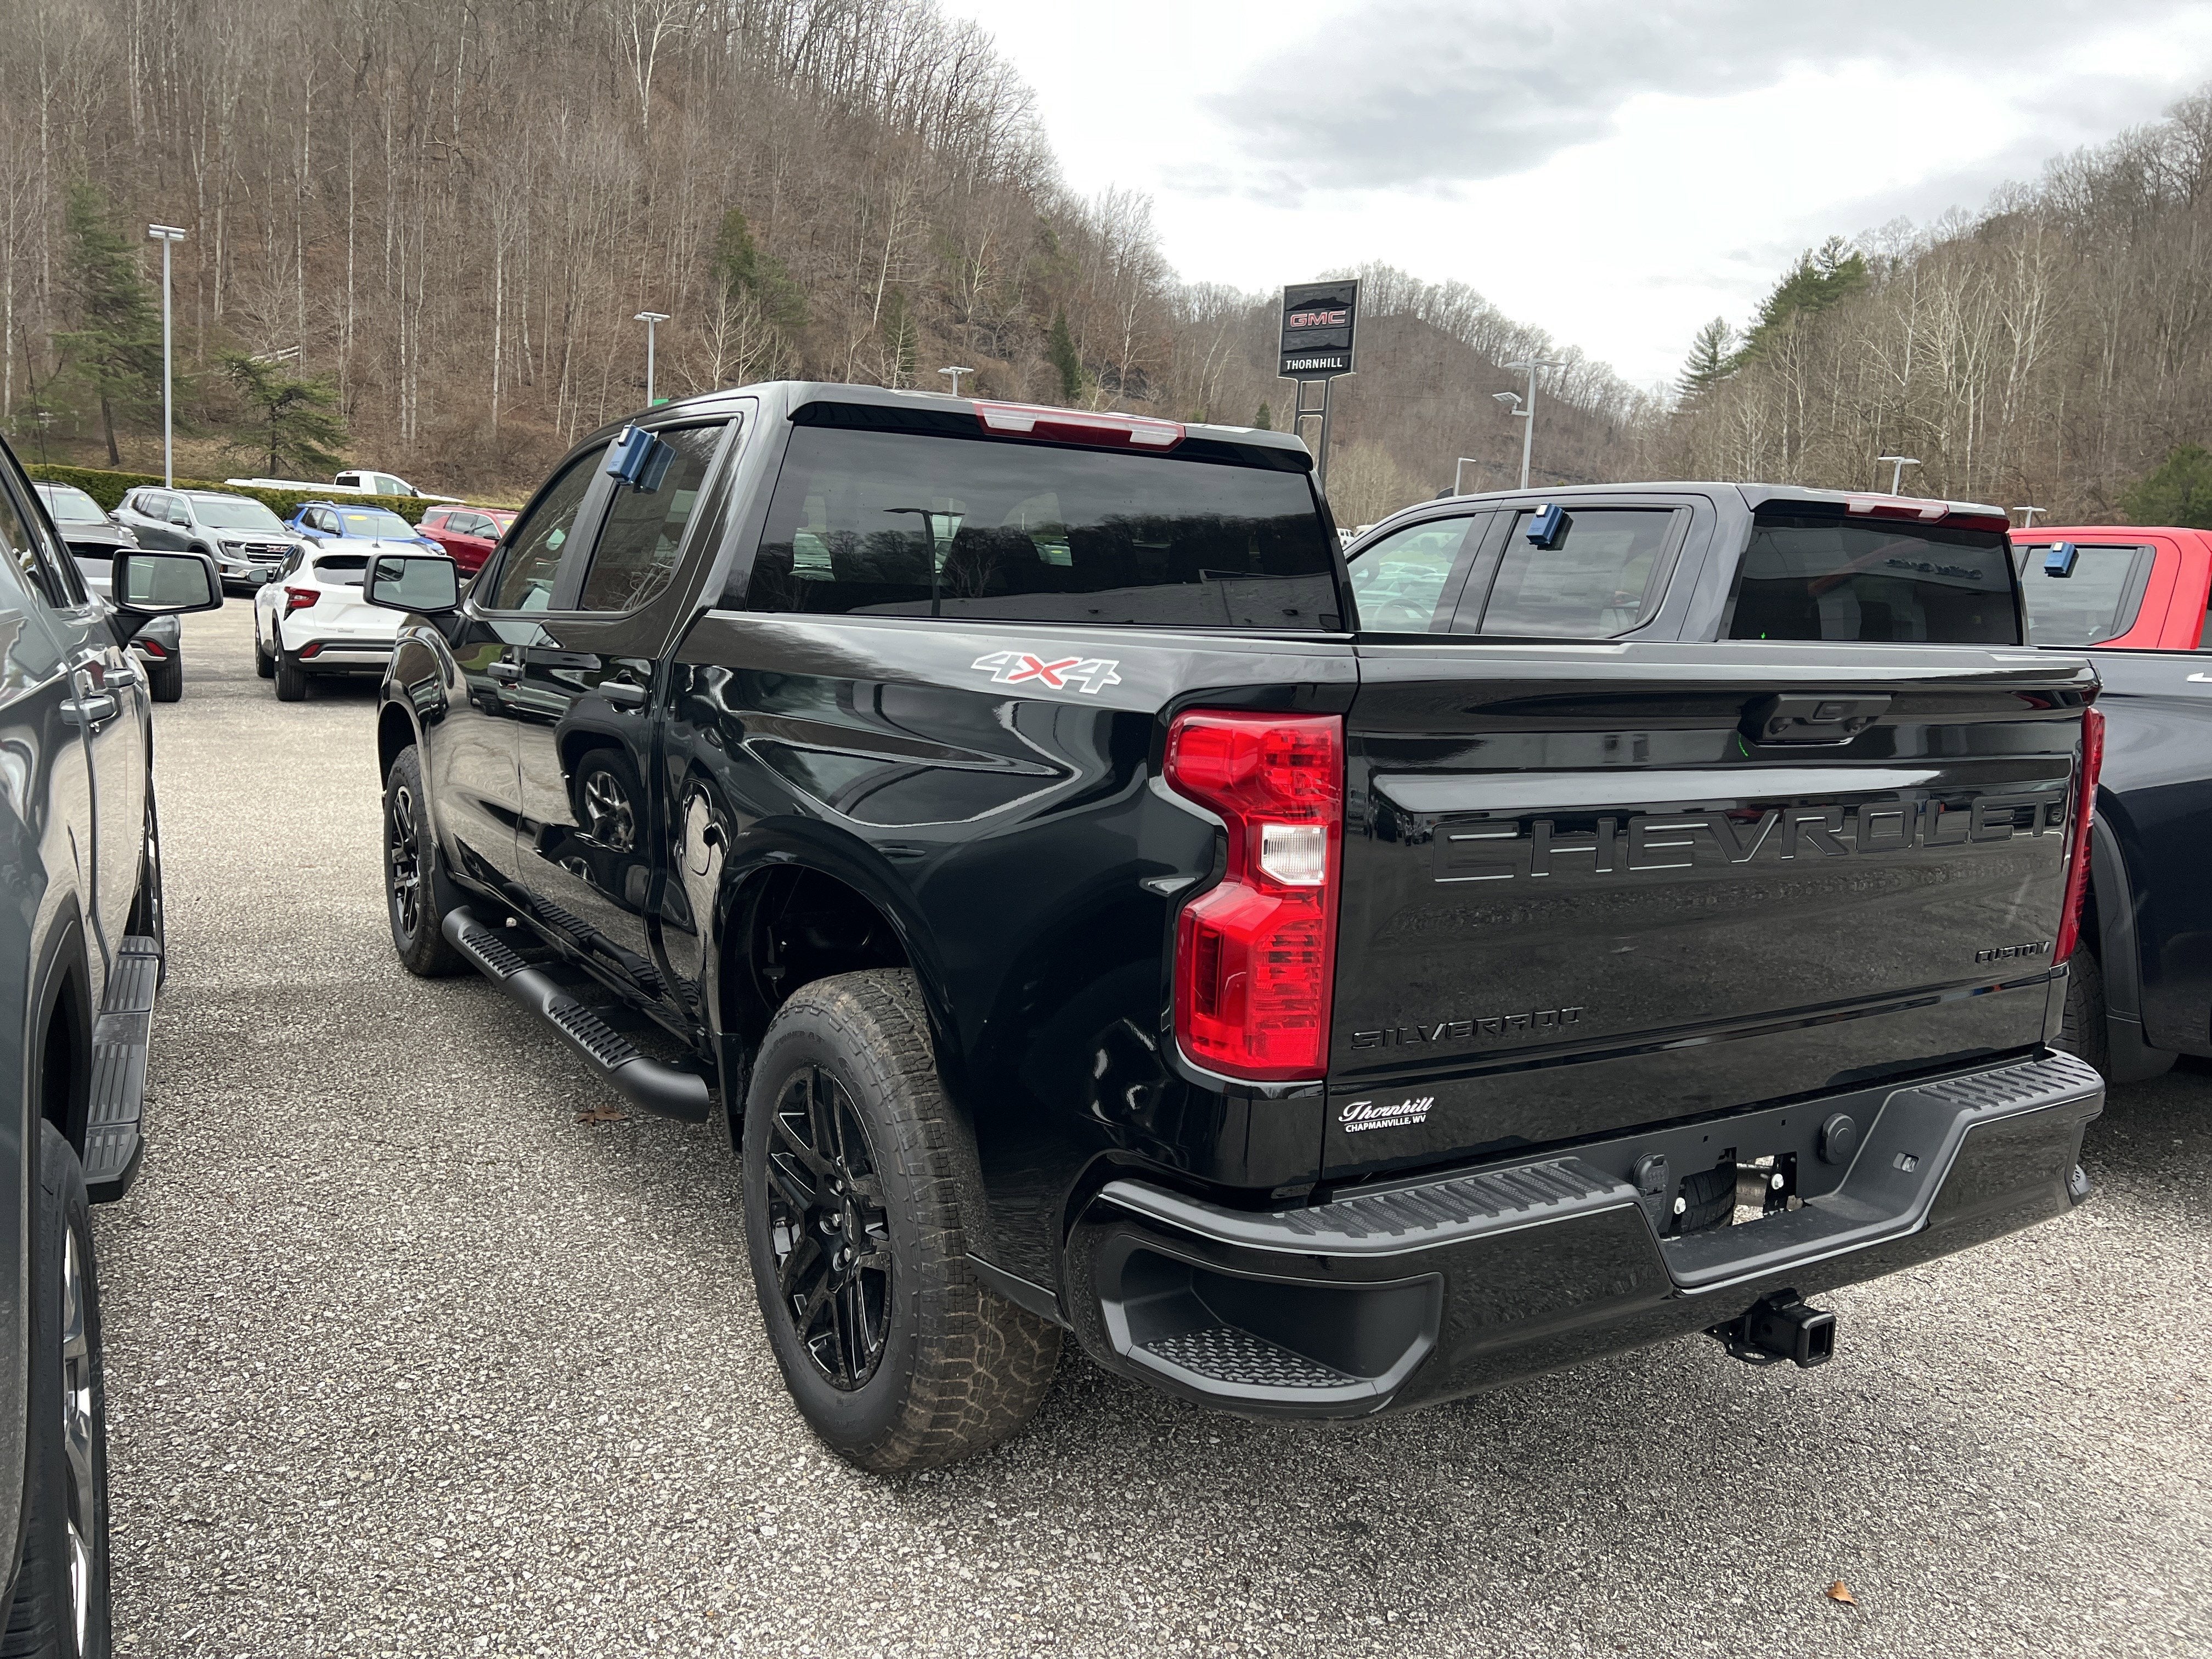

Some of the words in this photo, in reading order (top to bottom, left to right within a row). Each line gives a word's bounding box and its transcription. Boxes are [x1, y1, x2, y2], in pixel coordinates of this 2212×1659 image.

[1290, 311, 1346, 327] GMC
[1286, 358, 1342, 369] THORNHILL
[1432, 790, 2063, 882] CHEVROLET
[1975, 941, 2051, 963] CUSTOM
[1351, 1007, 1583, 1050] SILVERADO
[1338, 1097, 1435, 1122] Thornhill
[1346, 1117, 1411, 1133] CHAPMANVILLE,
[1412, 1114, 1426, 1123] WV
